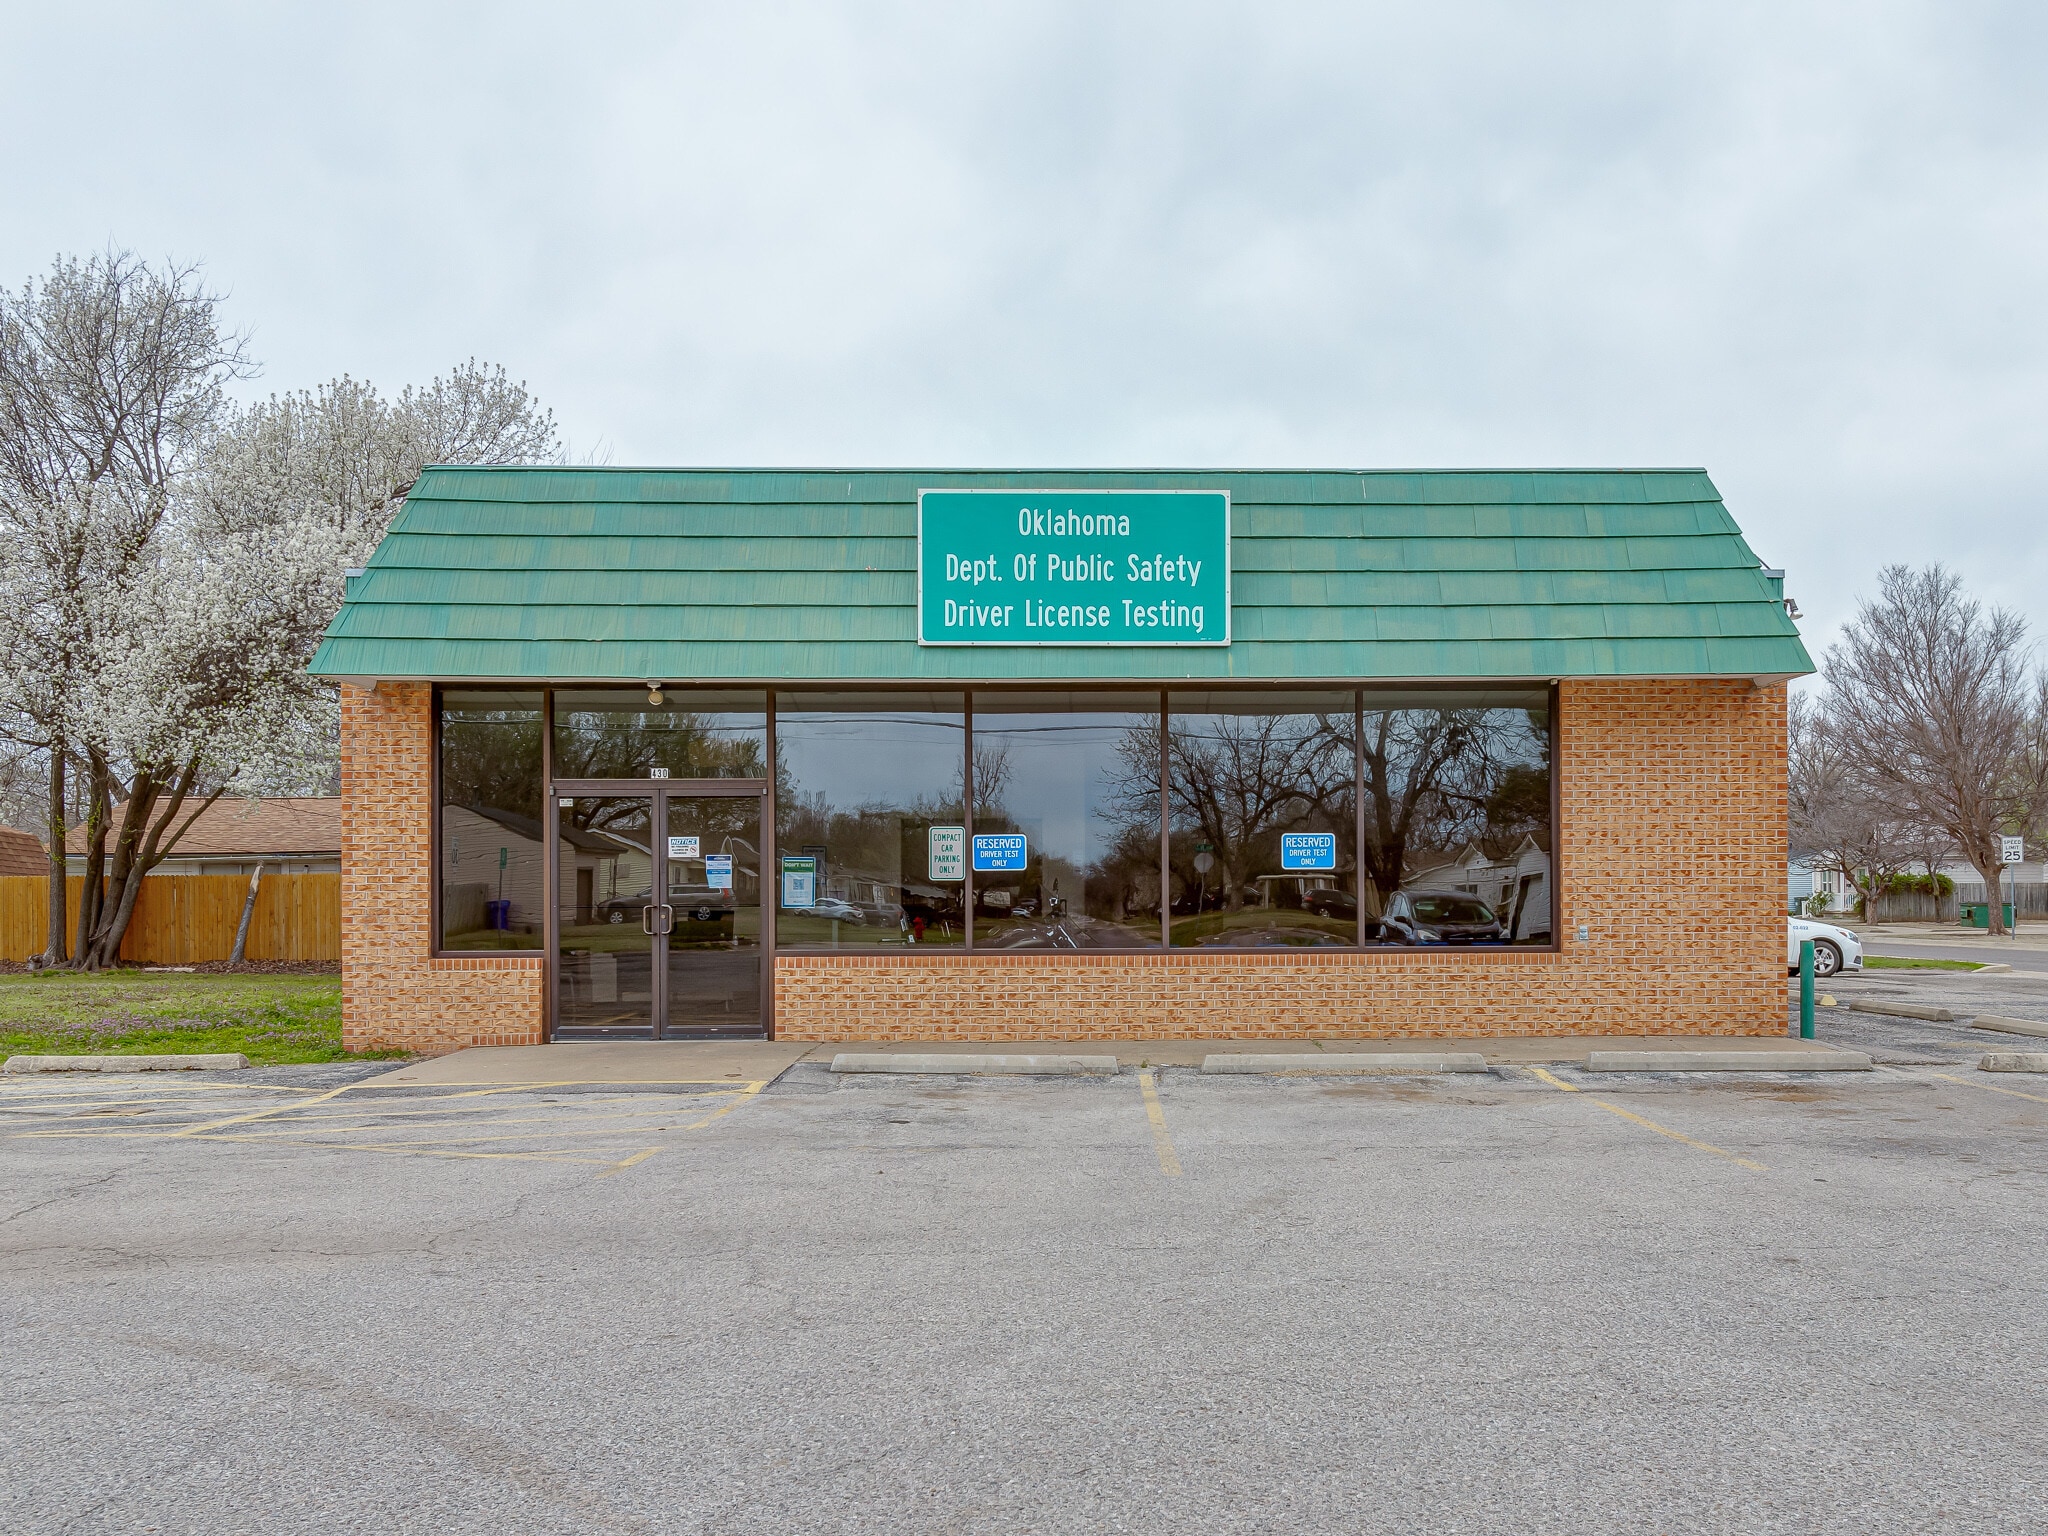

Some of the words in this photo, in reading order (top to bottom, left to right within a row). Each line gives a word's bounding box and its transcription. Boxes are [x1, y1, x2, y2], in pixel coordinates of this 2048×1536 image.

[1018, 507, 1130, 536] Oklahoma
[945, 553, 1003, 586] Dept.
[1013, 553, 1037, 582] Of
[1047, 553, 1115, 582] Public
[1127, 553, 1202, 587] Safety
[944, 599, 1014, 627] Driver
[1025, 599, 1111, 627] License
[1122, 599, 1205, 634] Testing
[652, 769, 668, 778] 430
[933, 833, 961, 842] COMPACT
[976, 838, 1022, 849] RESERVED
[1285, 837, 1331, 848] RESERVED
[941, 844, 953, 852] CAR
[980, 850, 1002, 858] DRIVER
[1004, 850, 1019, 858] TEST
[1289, 849, 1311, 857] DRIVER
[2004, 851, 2021, 860] 25
[934, 855, 961, 863] PARKING
[991, 859, 1008, 867] ONLY
[1300, 858, 1316, 866] ONLY
[939, 865, 956, 874] ONLY
